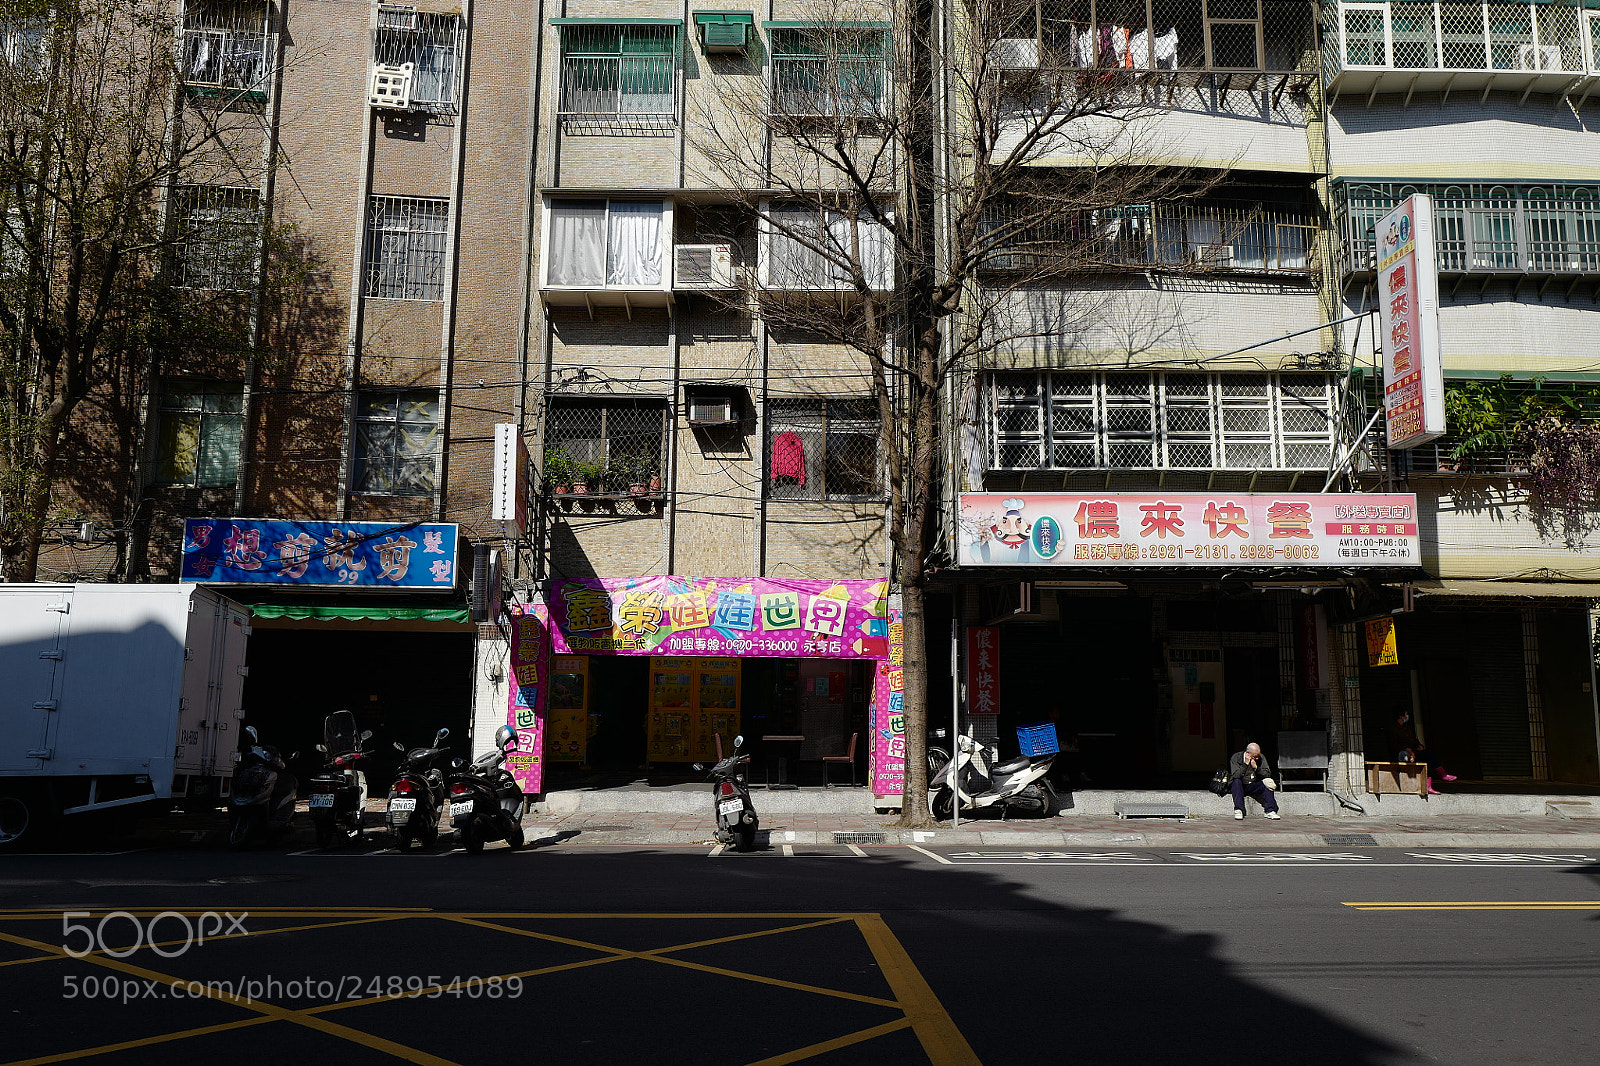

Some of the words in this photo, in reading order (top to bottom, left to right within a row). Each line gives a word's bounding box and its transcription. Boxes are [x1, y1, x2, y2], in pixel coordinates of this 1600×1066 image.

[1389, 265, 1411, 376] 儂來快餐
[1041, 518, 1051, 554] 儂來快餐
[1073, 501, 1314, 539] 儂來快餐
[1341, 524, 1405, 534] 服務時間
[223, 524, 418, 582] 想剪就剪
[338, 569, 359, 585] 99
[564, 588, 844, 635] 鑫榮娃娃世界
